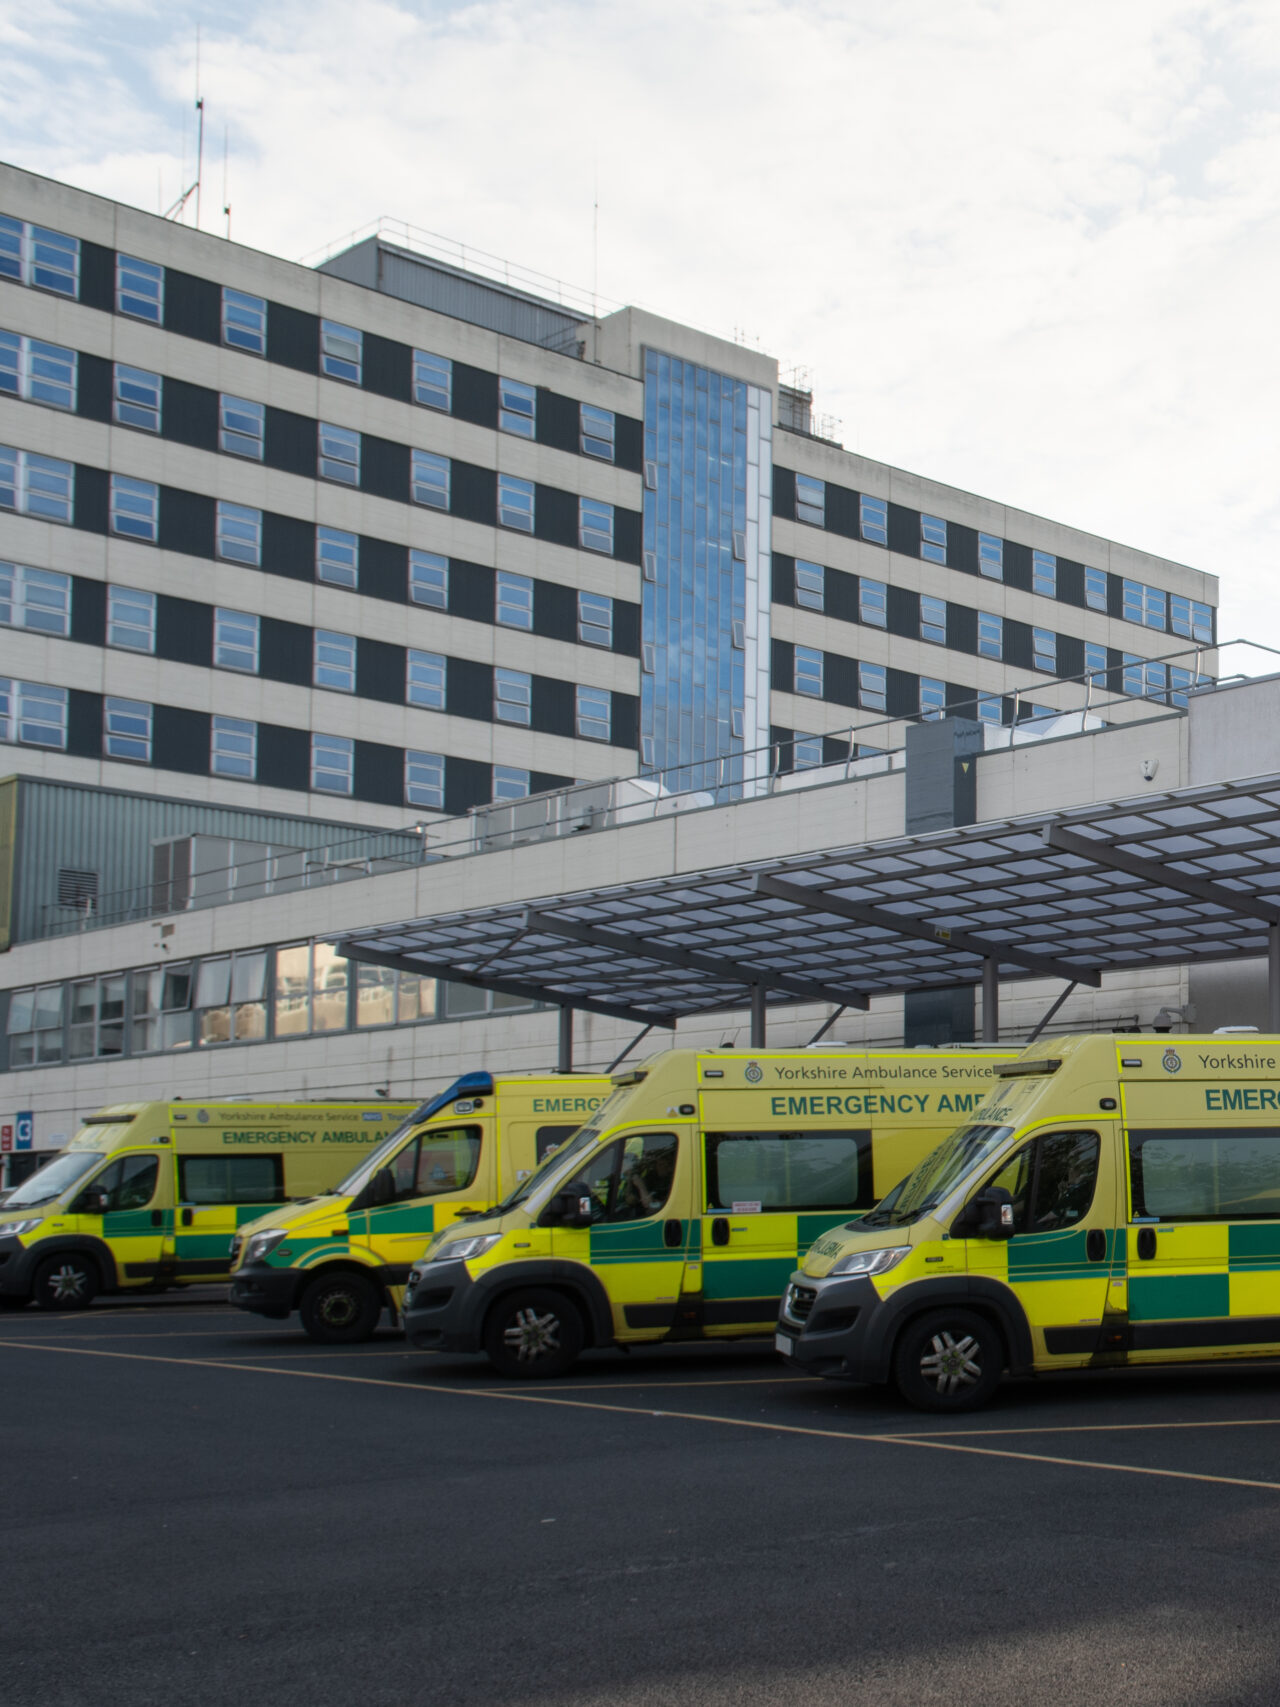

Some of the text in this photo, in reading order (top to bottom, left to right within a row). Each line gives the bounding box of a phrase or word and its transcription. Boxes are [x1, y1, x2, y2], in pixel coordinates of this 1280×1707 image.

[1199, 1054, 1276, 1069] Yorkshire
[775, 1065, 993, 1080] Yorkshire Ambulance Service
[533, 1098, 606, 1113] EMERG
[771, 1095, 928, 1115] EMERGENCY
[222, 1131, 316, 1144] EMERGENCY
